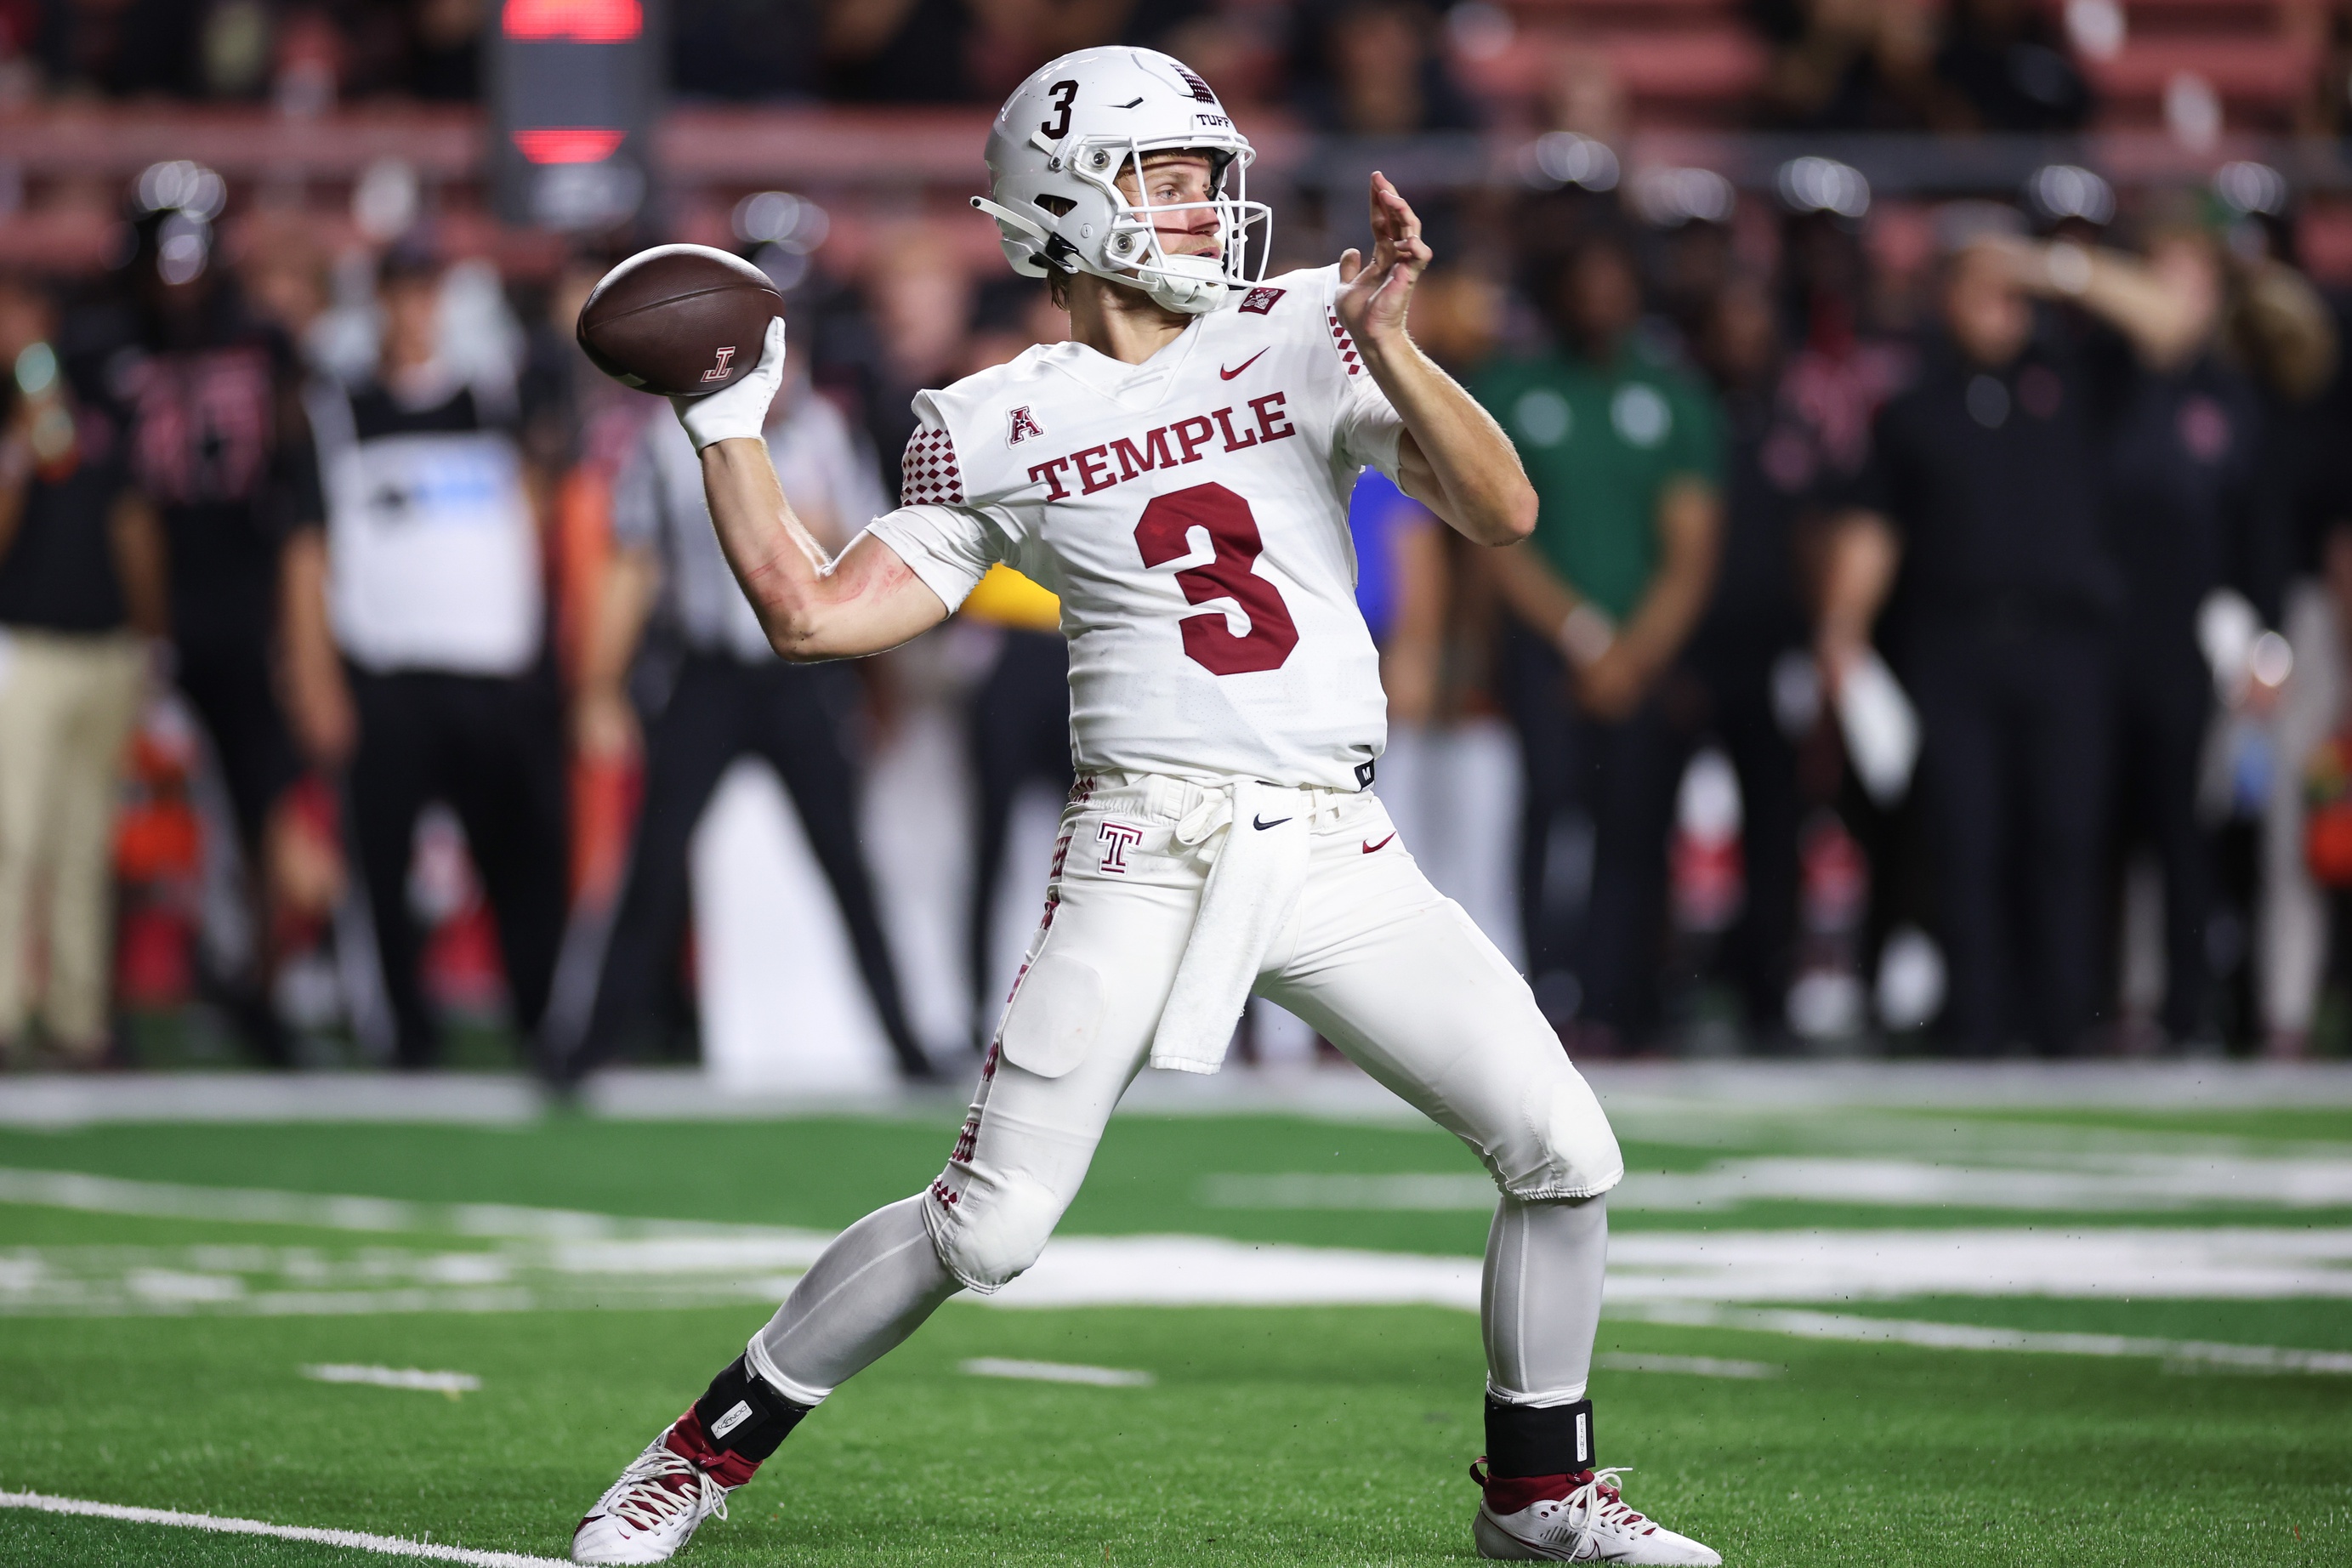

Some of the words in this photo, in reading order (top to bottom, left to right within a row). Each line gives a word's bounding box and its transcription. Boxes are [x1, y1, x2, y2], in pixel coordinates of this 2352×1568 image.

[1041, 79, 1079, 139] 3
[1196, 114, 1230, 128] TUFF
[701, 346, 736, 383] T
[1009, 406, 1044, 445] A
[1028, 391, 1296, 502] TEMPLE
[1133, 481, 1299, 676] 3
[1099, 822, 1144, 873] T
